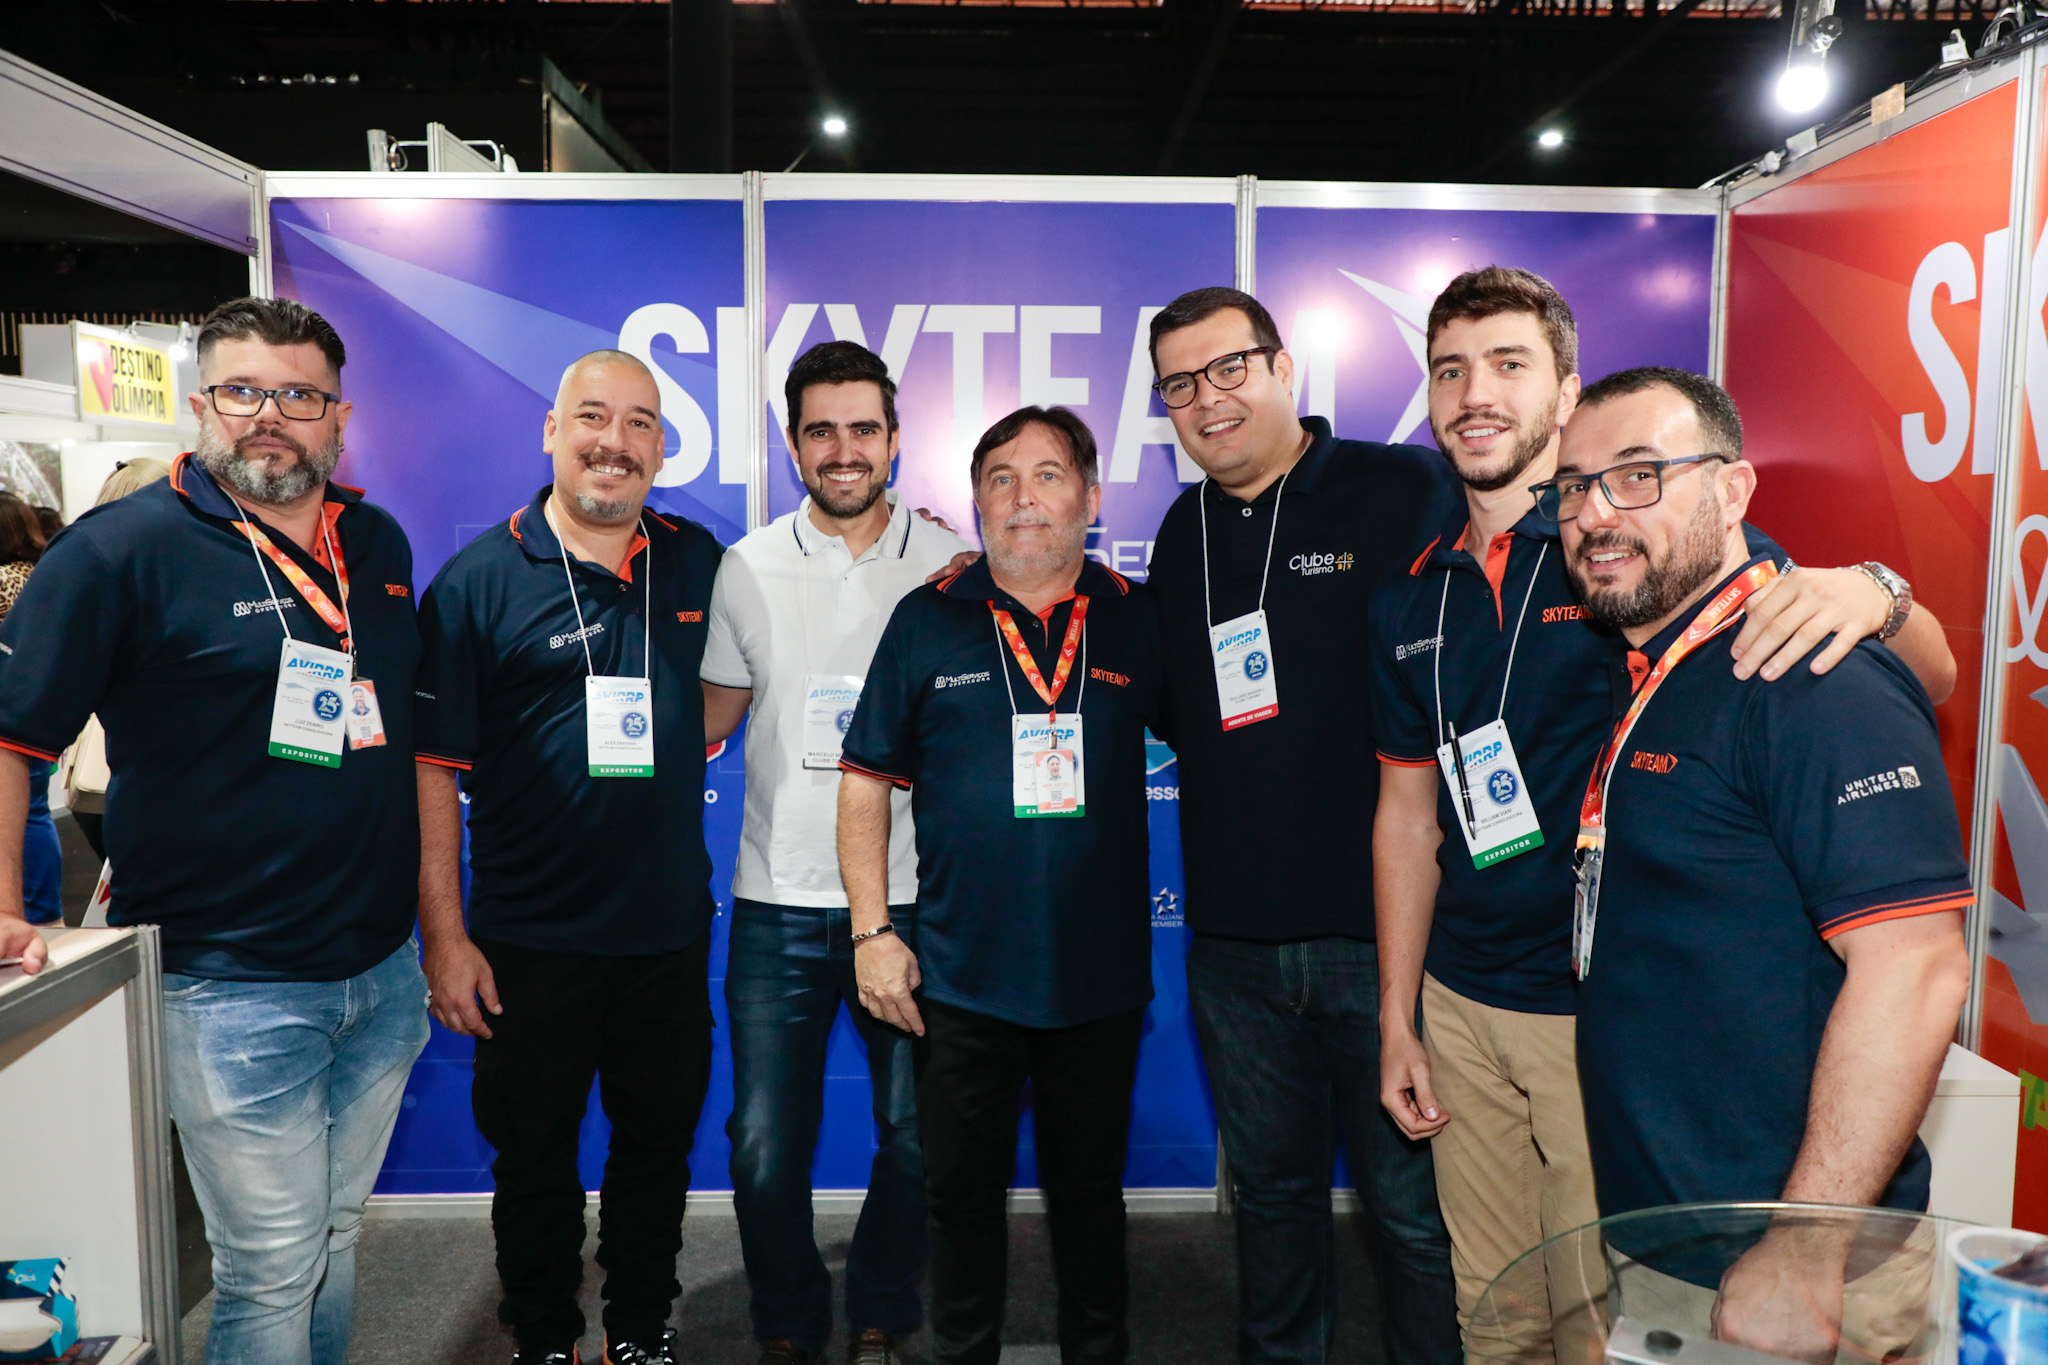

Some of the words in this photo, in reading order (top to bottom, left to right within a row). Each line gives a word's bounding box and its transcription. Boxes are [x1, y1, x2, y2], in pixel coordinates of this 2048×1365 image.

[110, 344, 162, 382] DESTINO
[112, 379, 166, 419] OLÍMPIA
[617, 303, 1336, 488] SKYTEAM
[1289, 552, 1335, 570] Clube
[1301, 565, 1334, 576] Turismo
[318, 600, 342, 627] SKYTEAM
[1708, 587, 1742, 619] SKYTEAM
[1217, 628, 1261, 652] AVIRRP
[286, 657, 344, 680] AVIRRP
[1091, 667, 1124, 686] SKYTEAM
[1228, 715, 1247, 727] AGENTE
[1247, 712, 1254, 721] DE
[1254, 708, 1273, 719] VIAGEM
[281, 748, 330, 762] EXPOSITOR
[1631, 751, 1669, 774] SKYTEAM
[1838, 779, 1900, 805] AIRLINES
[1845, 771, 1896, 793] UNITED
[1480, 812, 1500, 824] WILLIAM
[1485, 839, 1531, 862] EXPOSITOR
